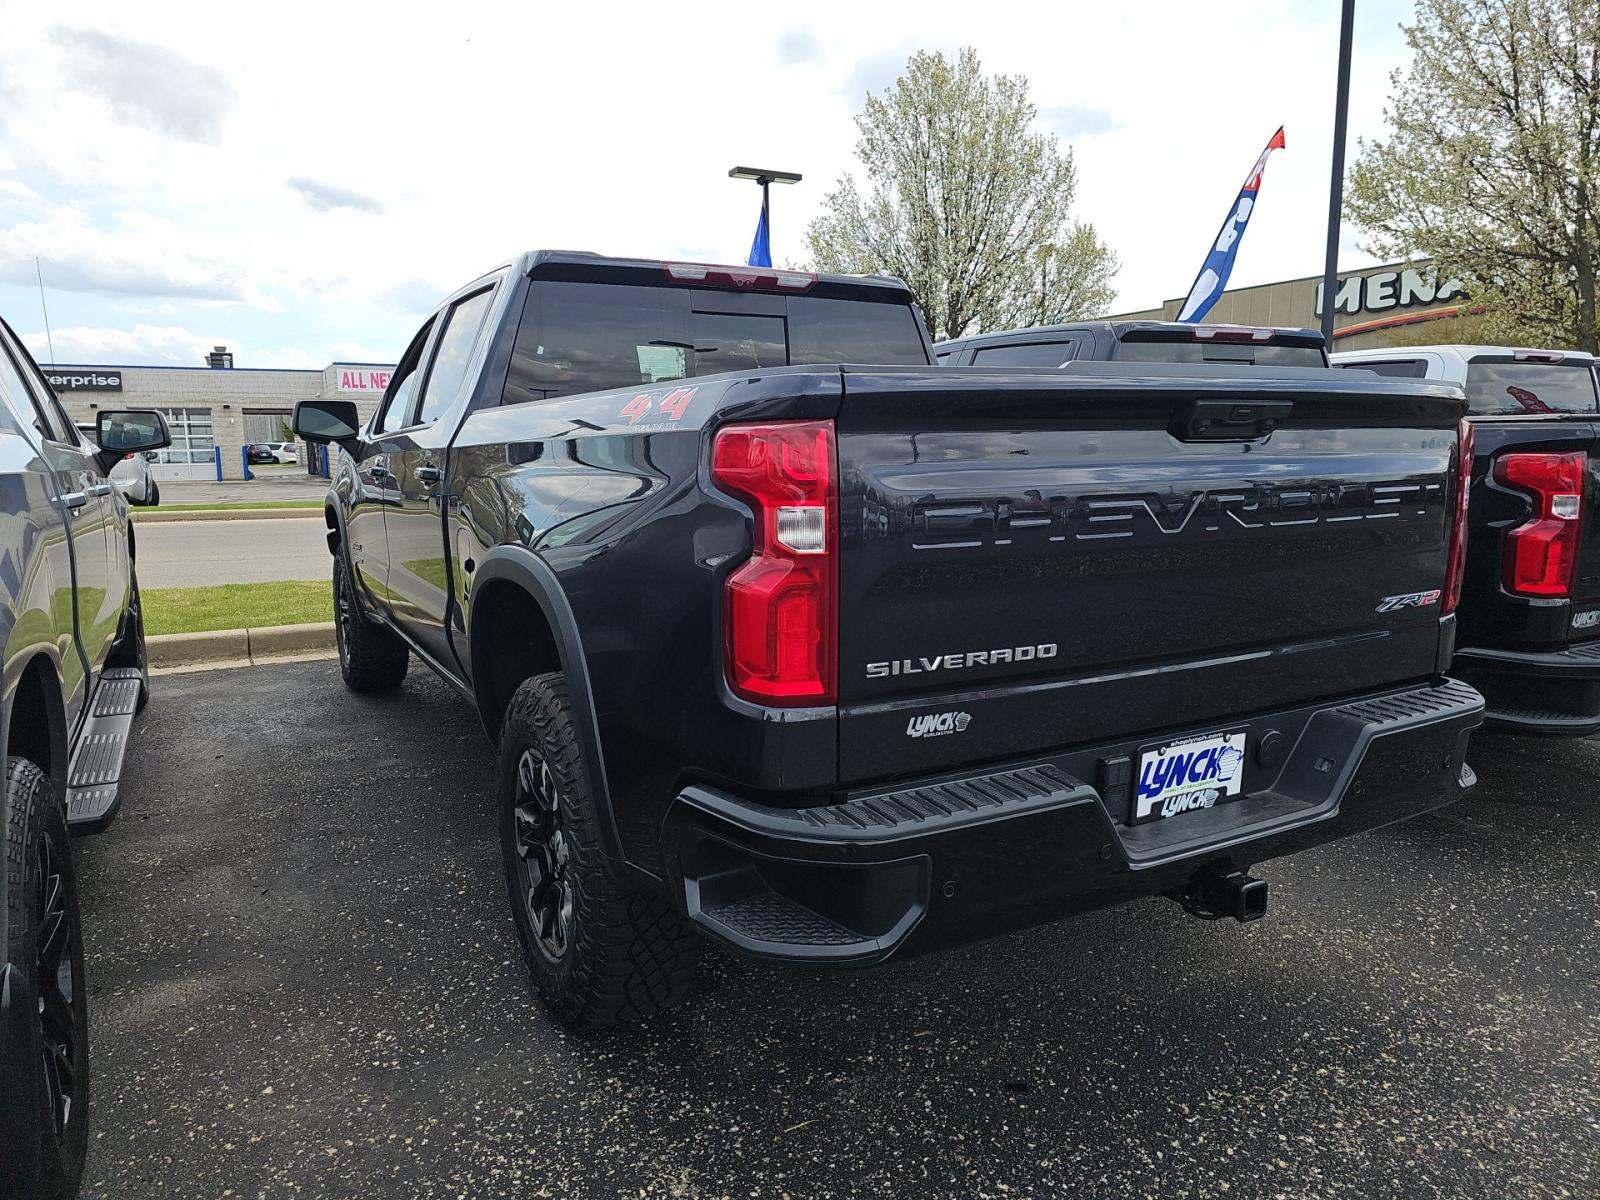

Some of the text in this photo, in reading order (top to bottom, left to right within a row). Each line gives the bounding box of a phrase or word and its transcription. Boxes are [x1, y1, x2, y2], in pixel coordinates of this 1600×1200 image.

[342, 372, 392, 388] ALL NE
[1374, 589, 1441, 612] ZR2
[866, 643, 1058, 678] SILVERADO
[906, 712, 958, 738] LYNCH
[1136, 745, 1227, 799] LYNCH
[1161, 790, 1207, 818] LYNCH
